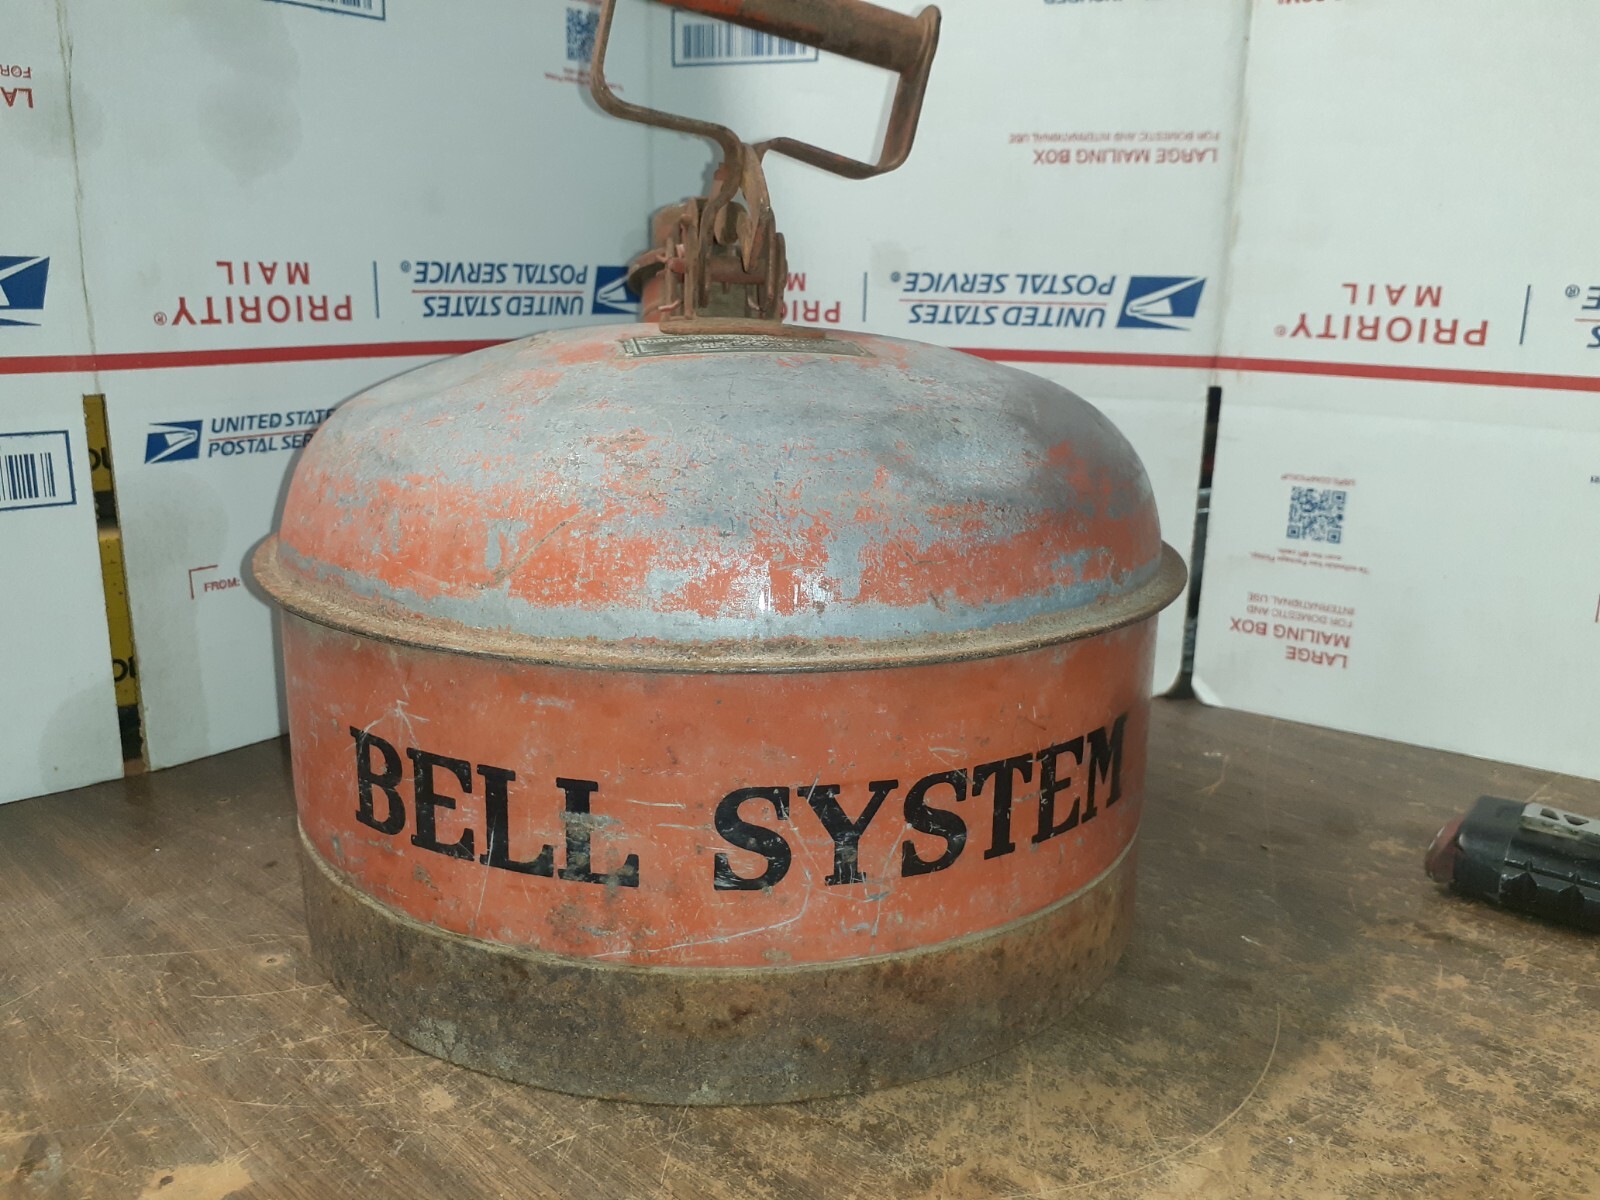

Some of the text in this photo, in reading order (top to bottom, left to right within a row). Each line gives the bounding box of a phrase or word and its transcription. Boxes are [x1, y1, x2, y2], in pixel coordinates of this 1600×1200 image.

[1033, 147, 1219, 165] LARGE MAILING BOX
[216, 261, 310, 285] MAIL
[513, 263, 588, 285] POSTAL
[1016, 273, 1117, 296] POSTAL
[423, 295, 584, 318] UNITED STATES
[1341, 283, 1443, 308] MAIL
[908, 304, 1106, 328] UNITED STATES
[211, 408, 337, 434] UNITED STATE
[208, 433, 314, 458] POSTAL SER
[1229, 616, 1351, 649] MAILING BOX
[1285, 645, 1348, 669] LARGE
[350, 711, 1129, 891] BELL SYSTEM
